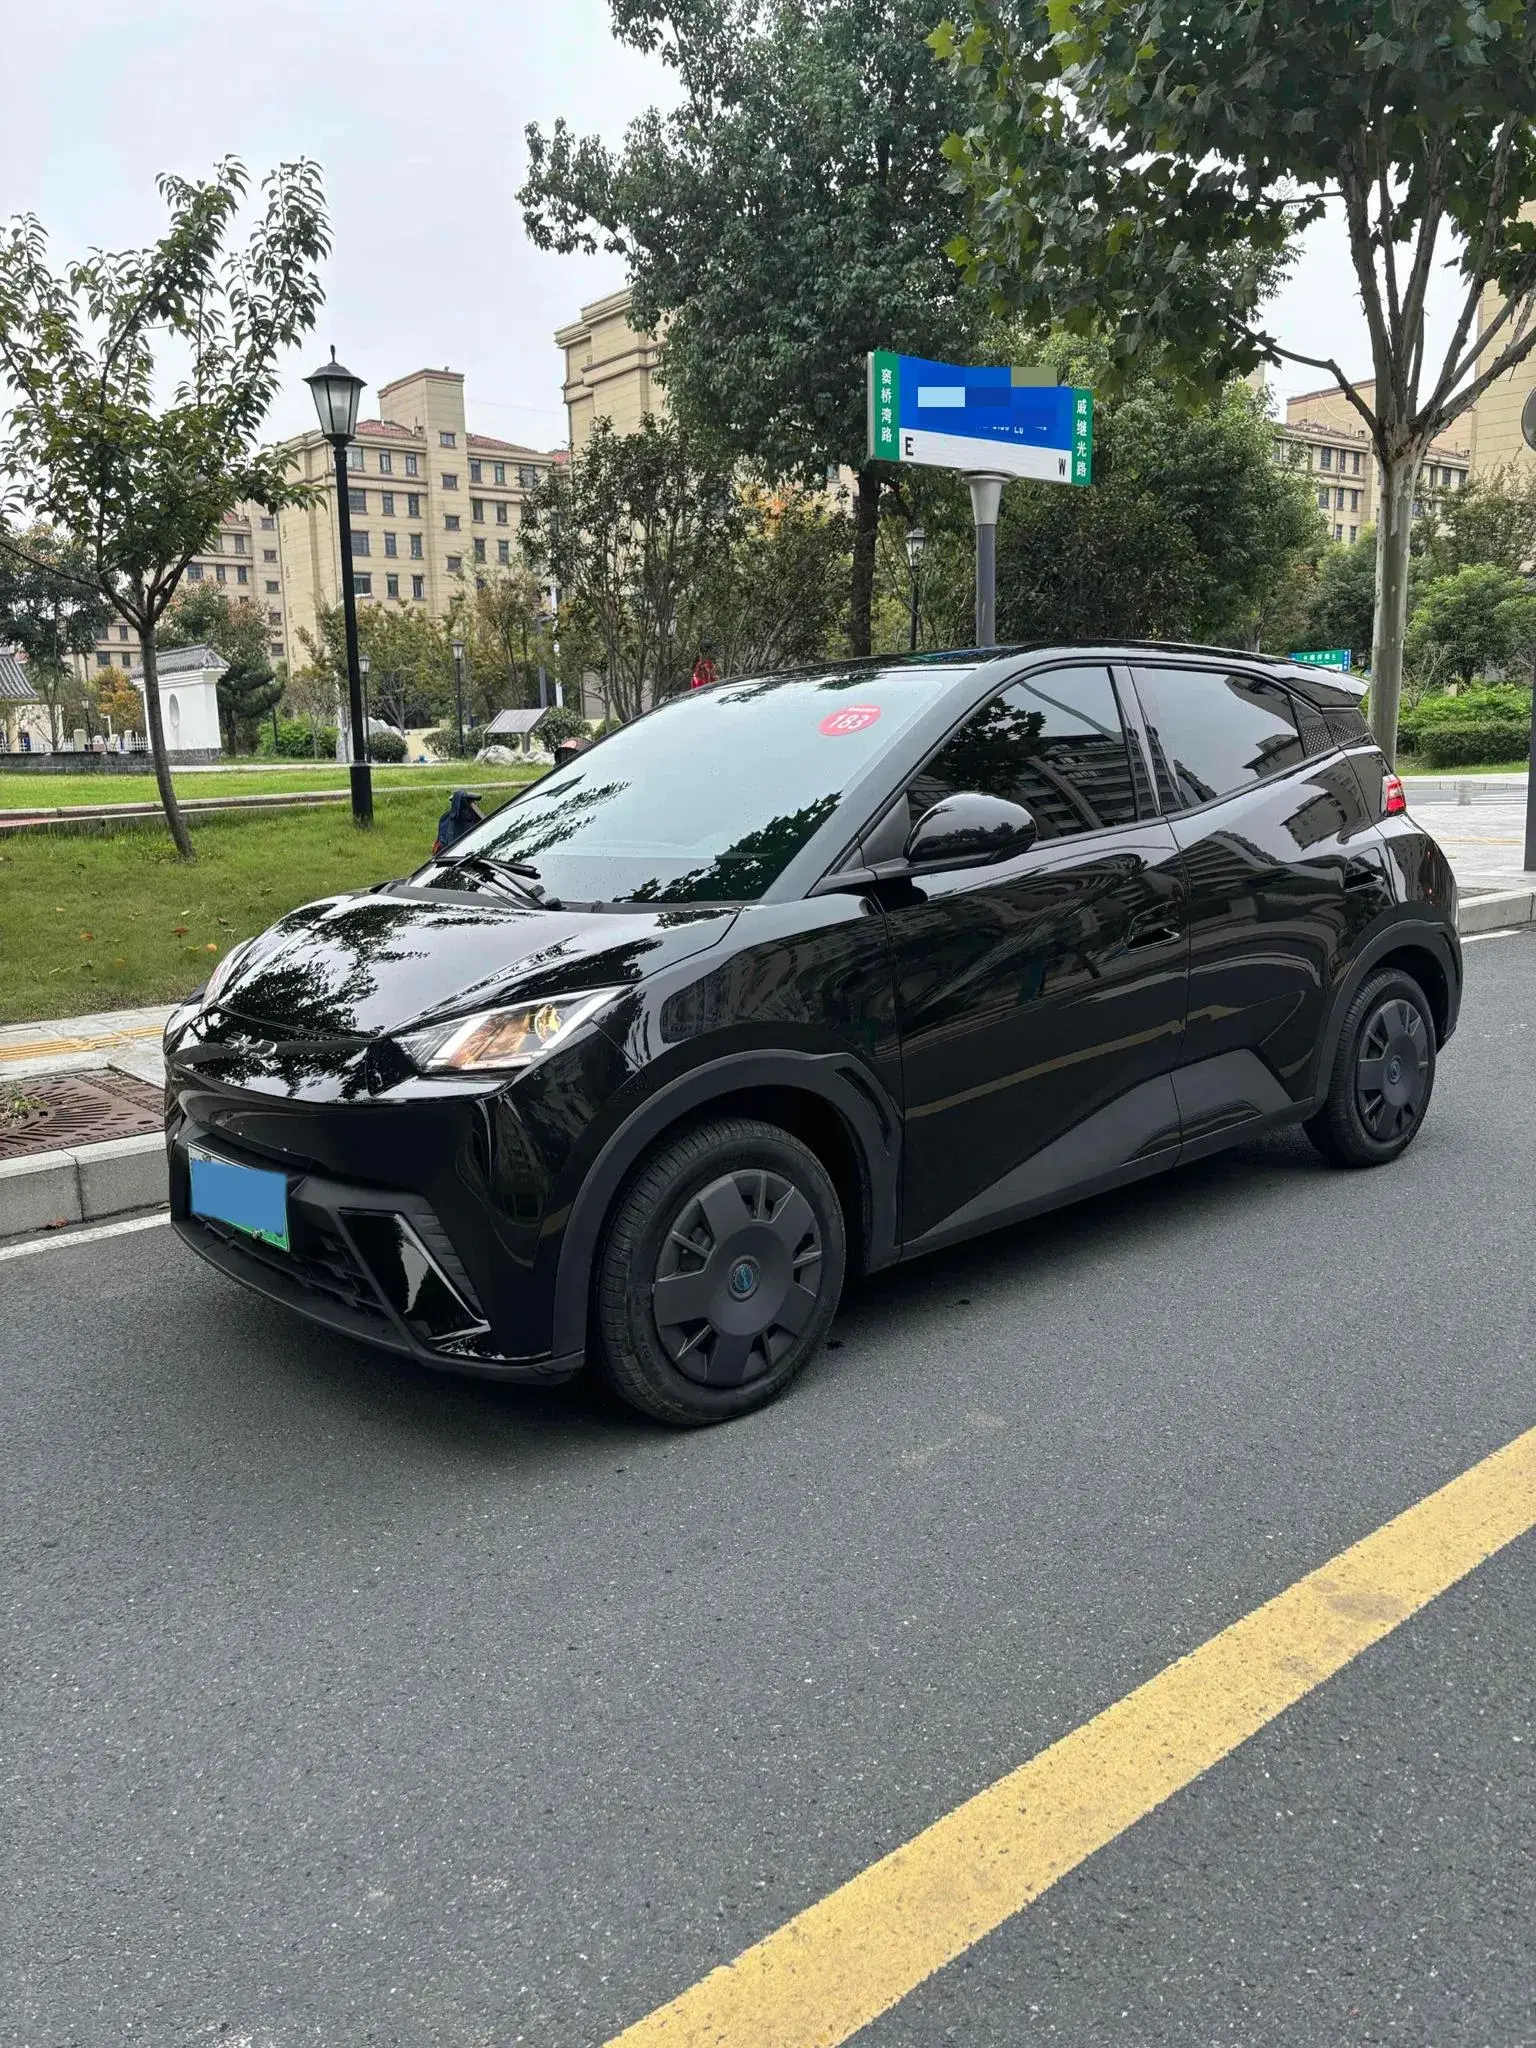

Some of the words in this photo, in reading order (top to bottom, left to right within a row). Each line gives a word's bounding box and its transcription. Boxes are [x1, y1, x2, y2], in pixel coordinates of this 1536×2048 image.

[905, 436, 914, 456] E
[1076, 398, 1087, 477] 戚继光路
[1058, 457, 1067, 477] W
[828, 713, 870, 730] 183
